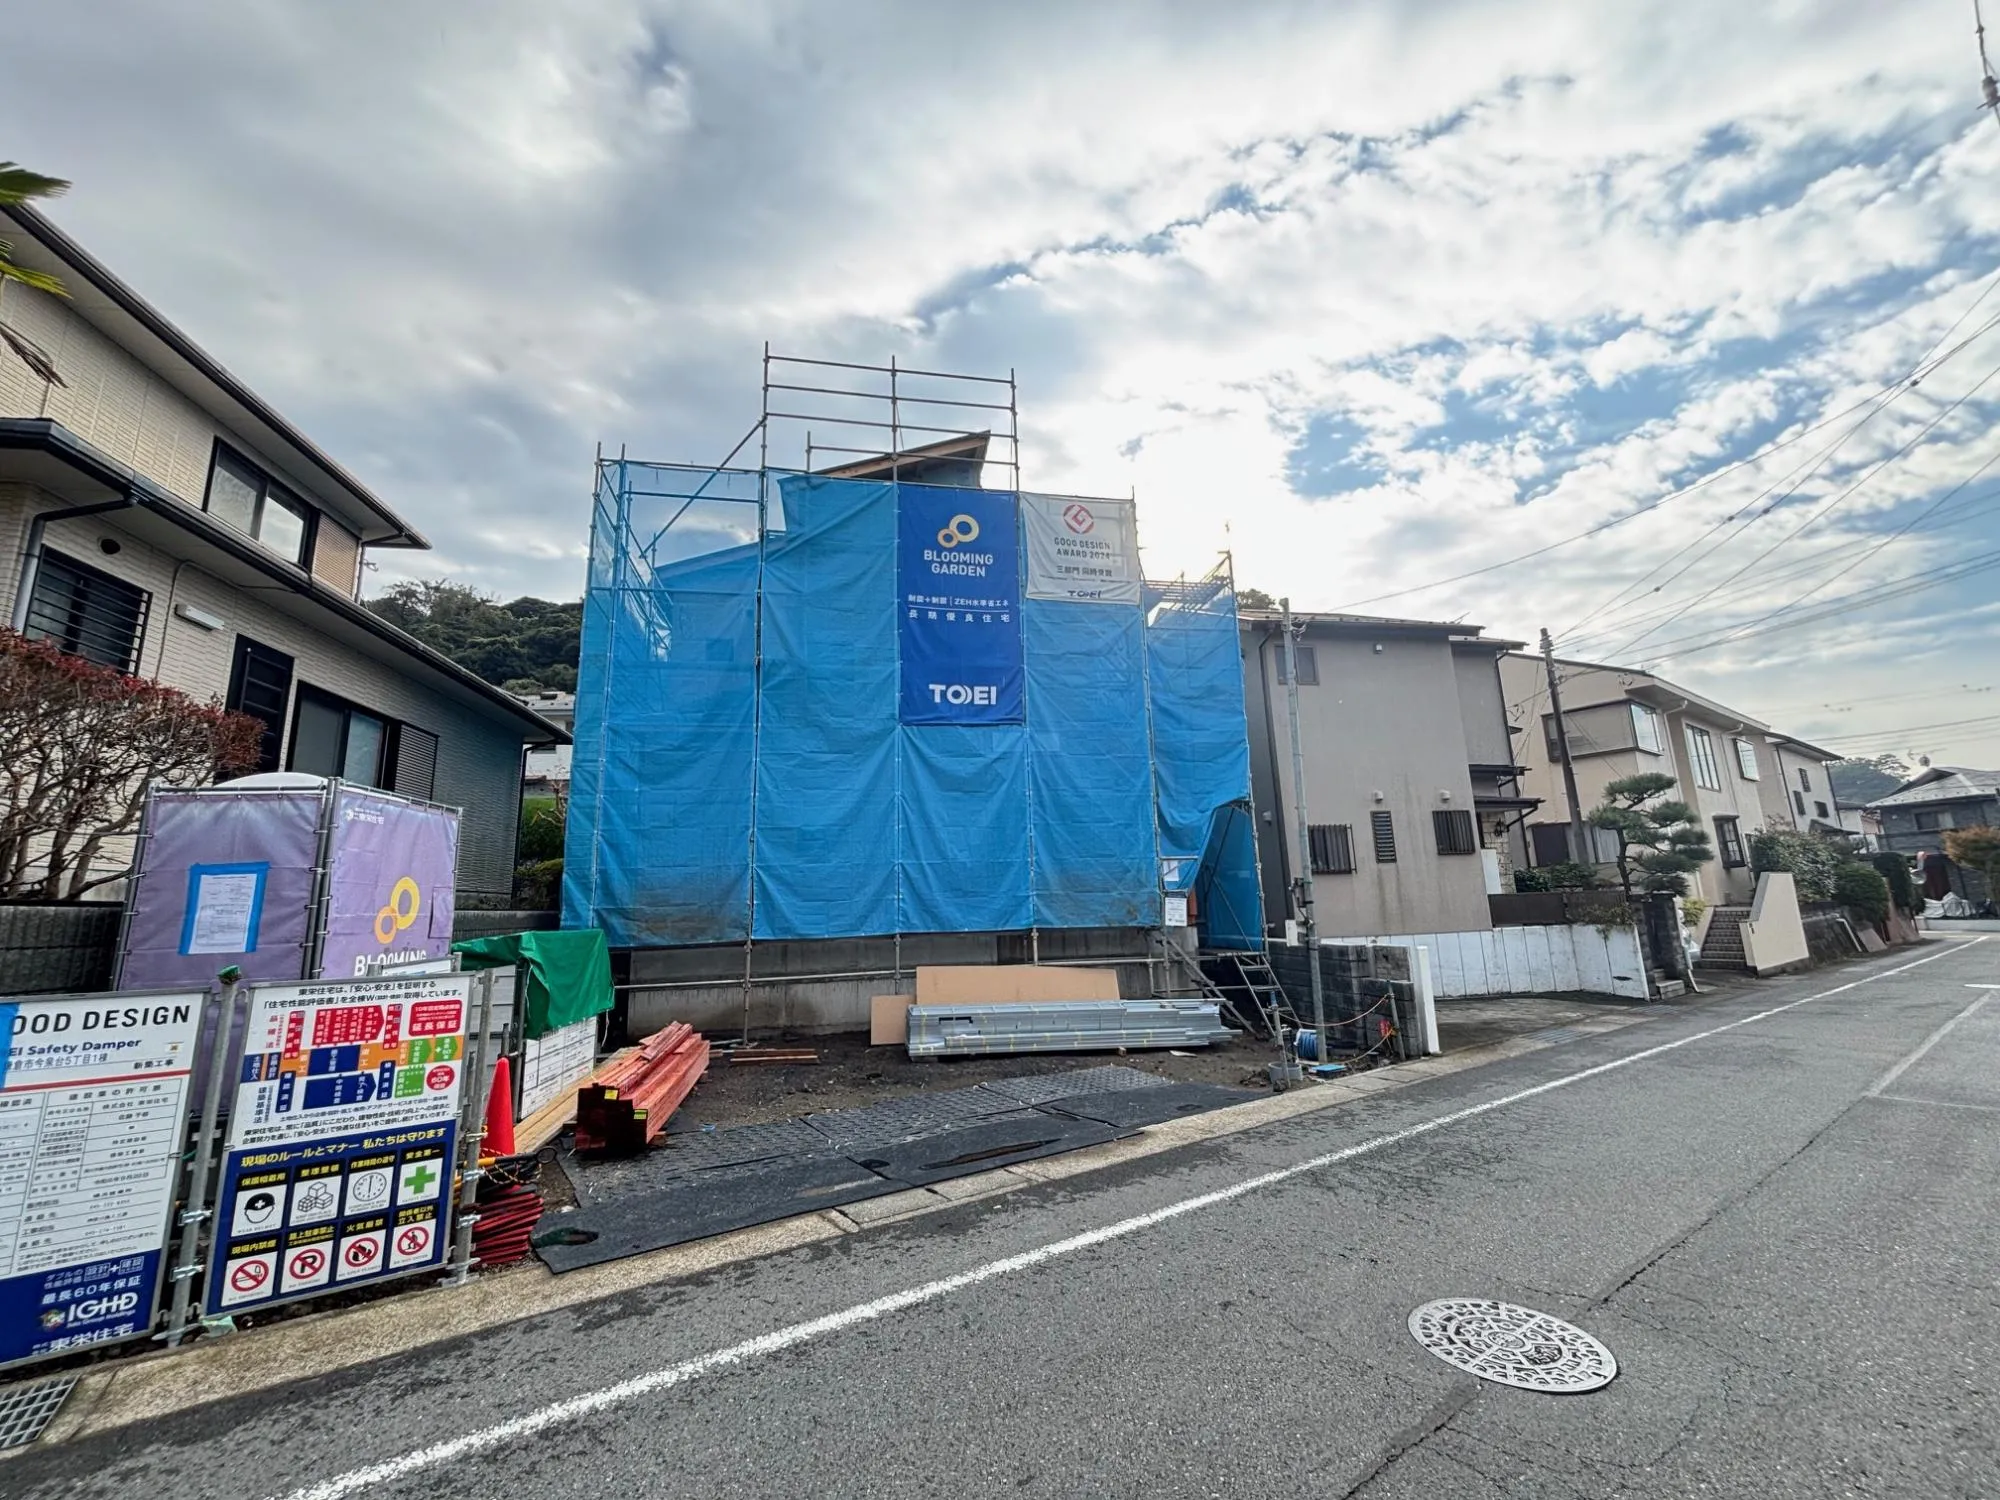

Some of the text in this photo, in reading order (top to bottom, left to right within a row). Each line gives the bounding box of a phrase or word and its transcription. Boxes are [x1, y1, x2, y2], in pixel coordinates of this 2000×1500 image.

[1054, 537, 1111, 550] GOOD DESIGN
[924, 550, 993, 564] BLOOMING
[1056, 548, 1087, 558] AWARD
[931, 563, 986, 577] GARDEN
[909, 609, 1010, 622] 長期優良住宅
[12, 1004, 190, 1035] OOD DESIGN
[8, 1036, 141, 1057] EI Safety Damper
[133, 1058, 174, 1069] 新築工事
[240, 1127, 446, 1167] 現場のルールとマナー 私たちは守ります
[405, 1147, 440, 1159] 安全第一
[397, 1211, 432, 1225] 立入禁止
[42, 1274, 141, 1305] 最長60年保証
[49, 1322, 134, 1352] 東栄住宅
